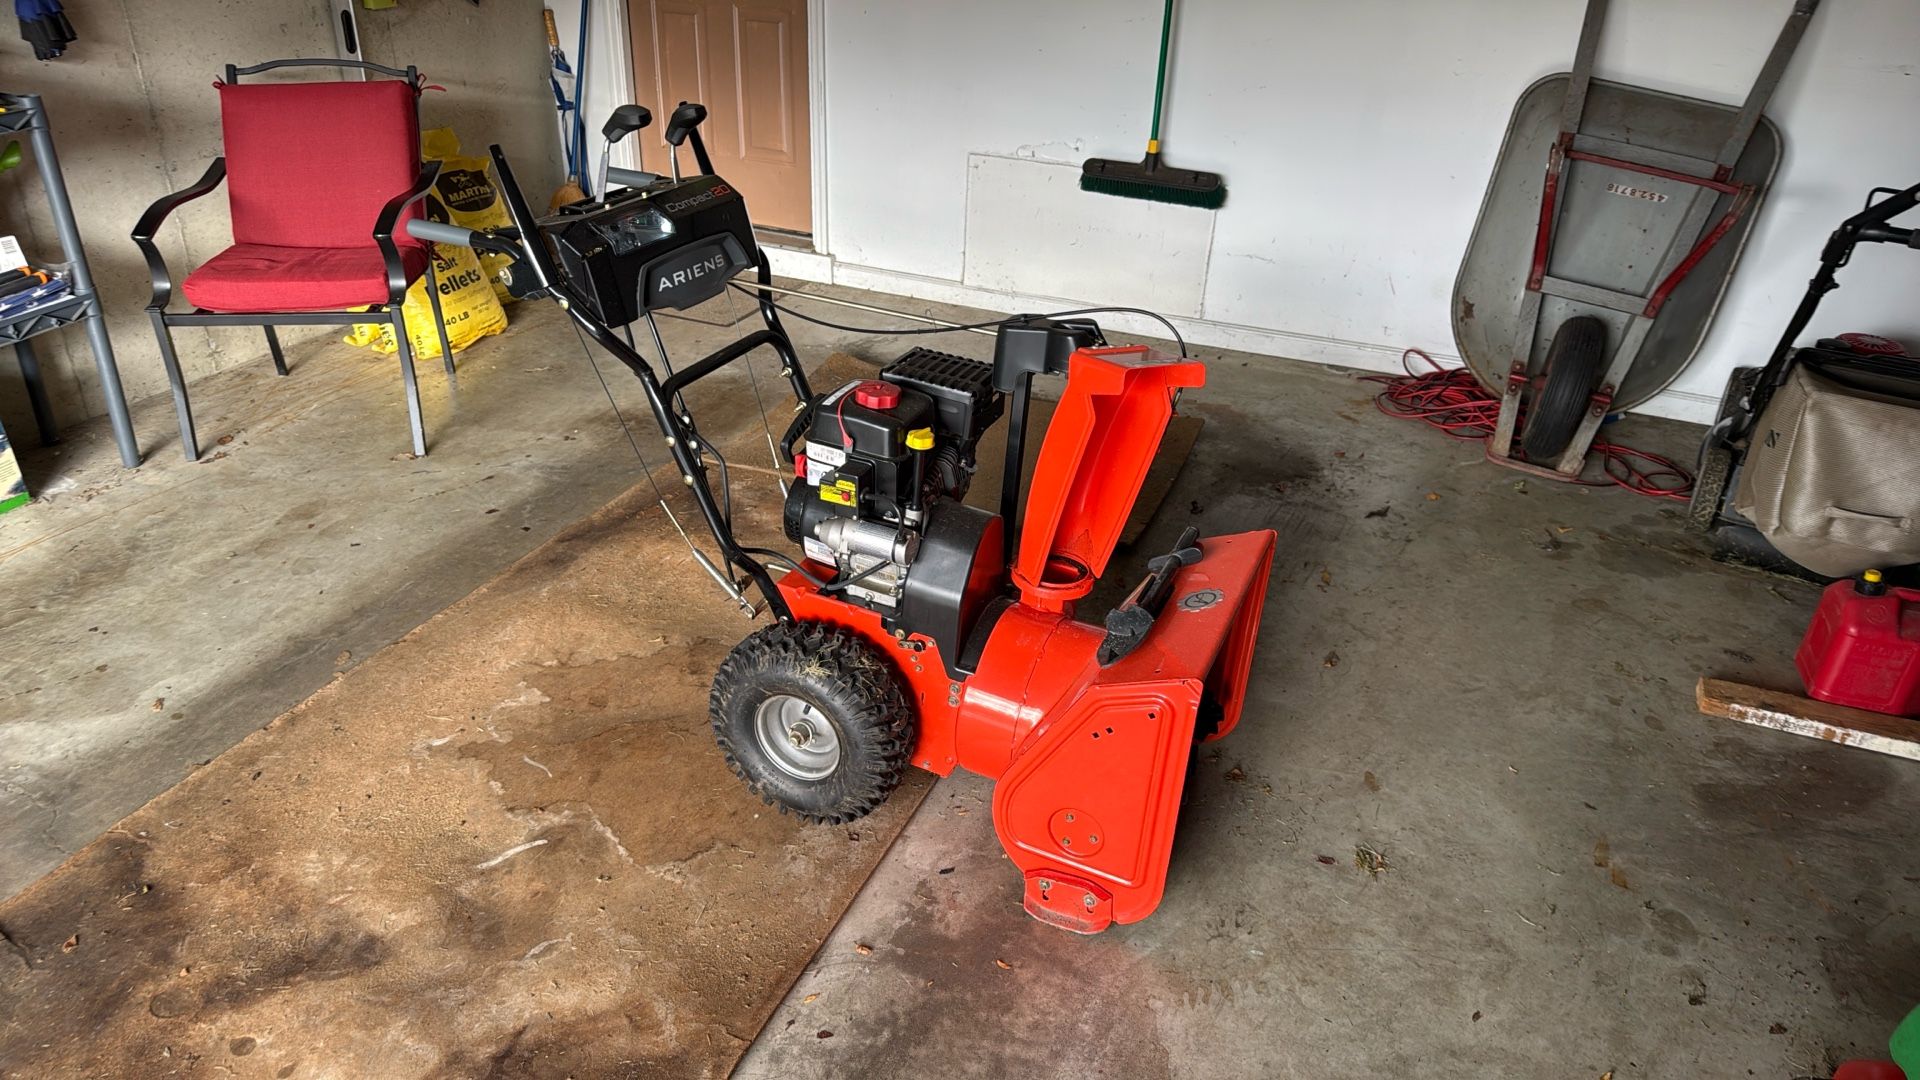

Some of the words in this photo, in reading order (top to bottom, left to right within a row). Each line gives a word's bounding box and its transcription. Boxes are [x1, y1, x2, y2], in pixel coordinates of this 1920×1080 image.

[436, 257, 458, 273] Salt
[657, 254, 725, 293] ARIENS
[426, 268, 481, 296] ellets
[445, 316, 457, 326] 40
[458, 311, 470, 321] LB
